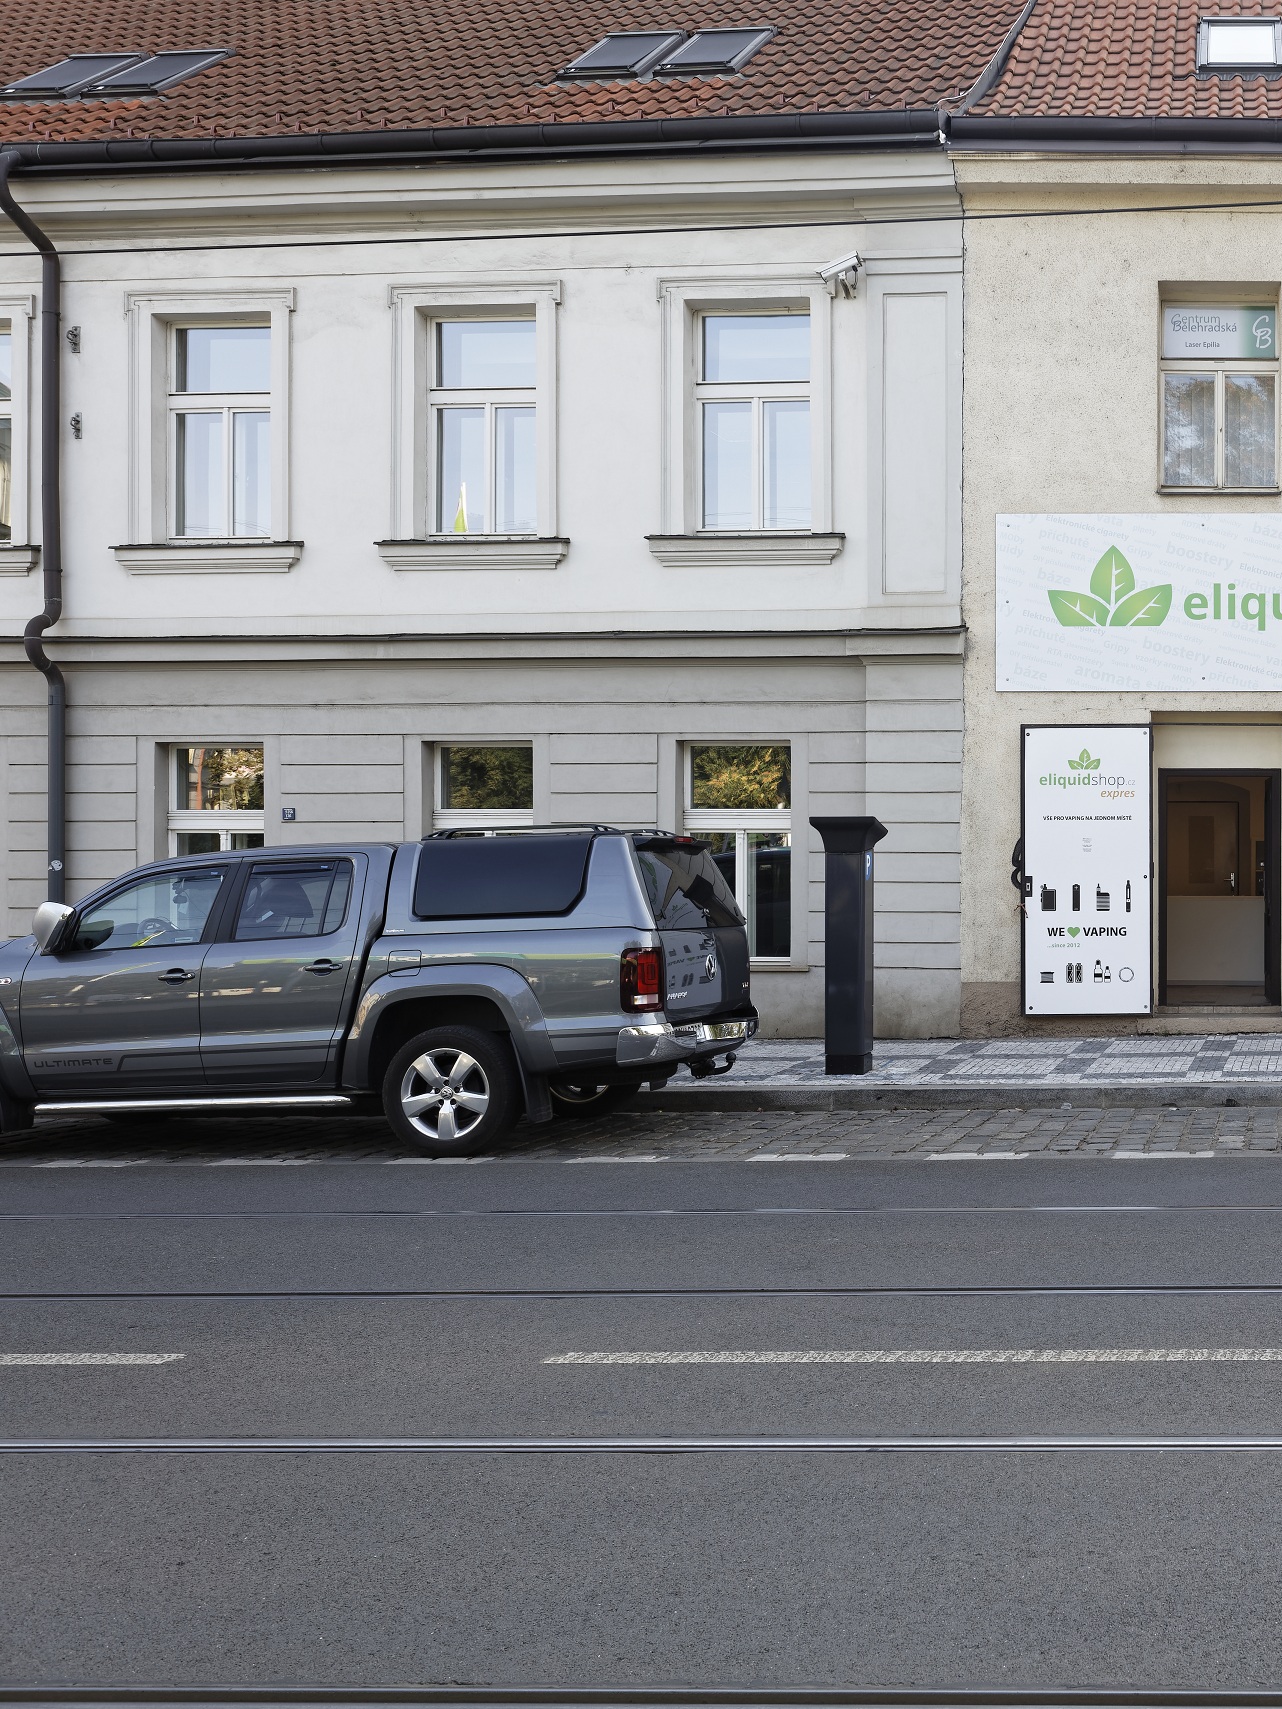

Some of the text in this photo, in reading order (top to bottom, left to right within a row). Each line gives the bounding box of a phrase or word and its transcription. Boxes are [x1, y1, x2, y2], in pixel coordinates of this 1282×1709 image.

[1171, 314, 1221, 323] Centrum
[1173, 320, 1238, 332] Bělehradská
[1045, 514, 1095, 533] Elektronické
[1096, 527, 1130, 542] cigarety
[1038, 528, 1090, 549] příchutě
[1166, 541, 1235, 570] boostery
[1036, 566, 1072, 586] báze
[1015, 624, 1066, 643] příchutě
[1103, 640, 1130, 655] Gripy
[1142, 636, 1211, 667] boostery
[1013, 662, 1048, 682] báze
[1215, 656, 1265, 675] Elektronické
[1074, 665, 1141, 690] aromata
[1100, 789, 1135, 800] expres
[1047, 926, 1127, 937] WE VAPING
[34, 1058, 114, 1068] ULTIMATE
